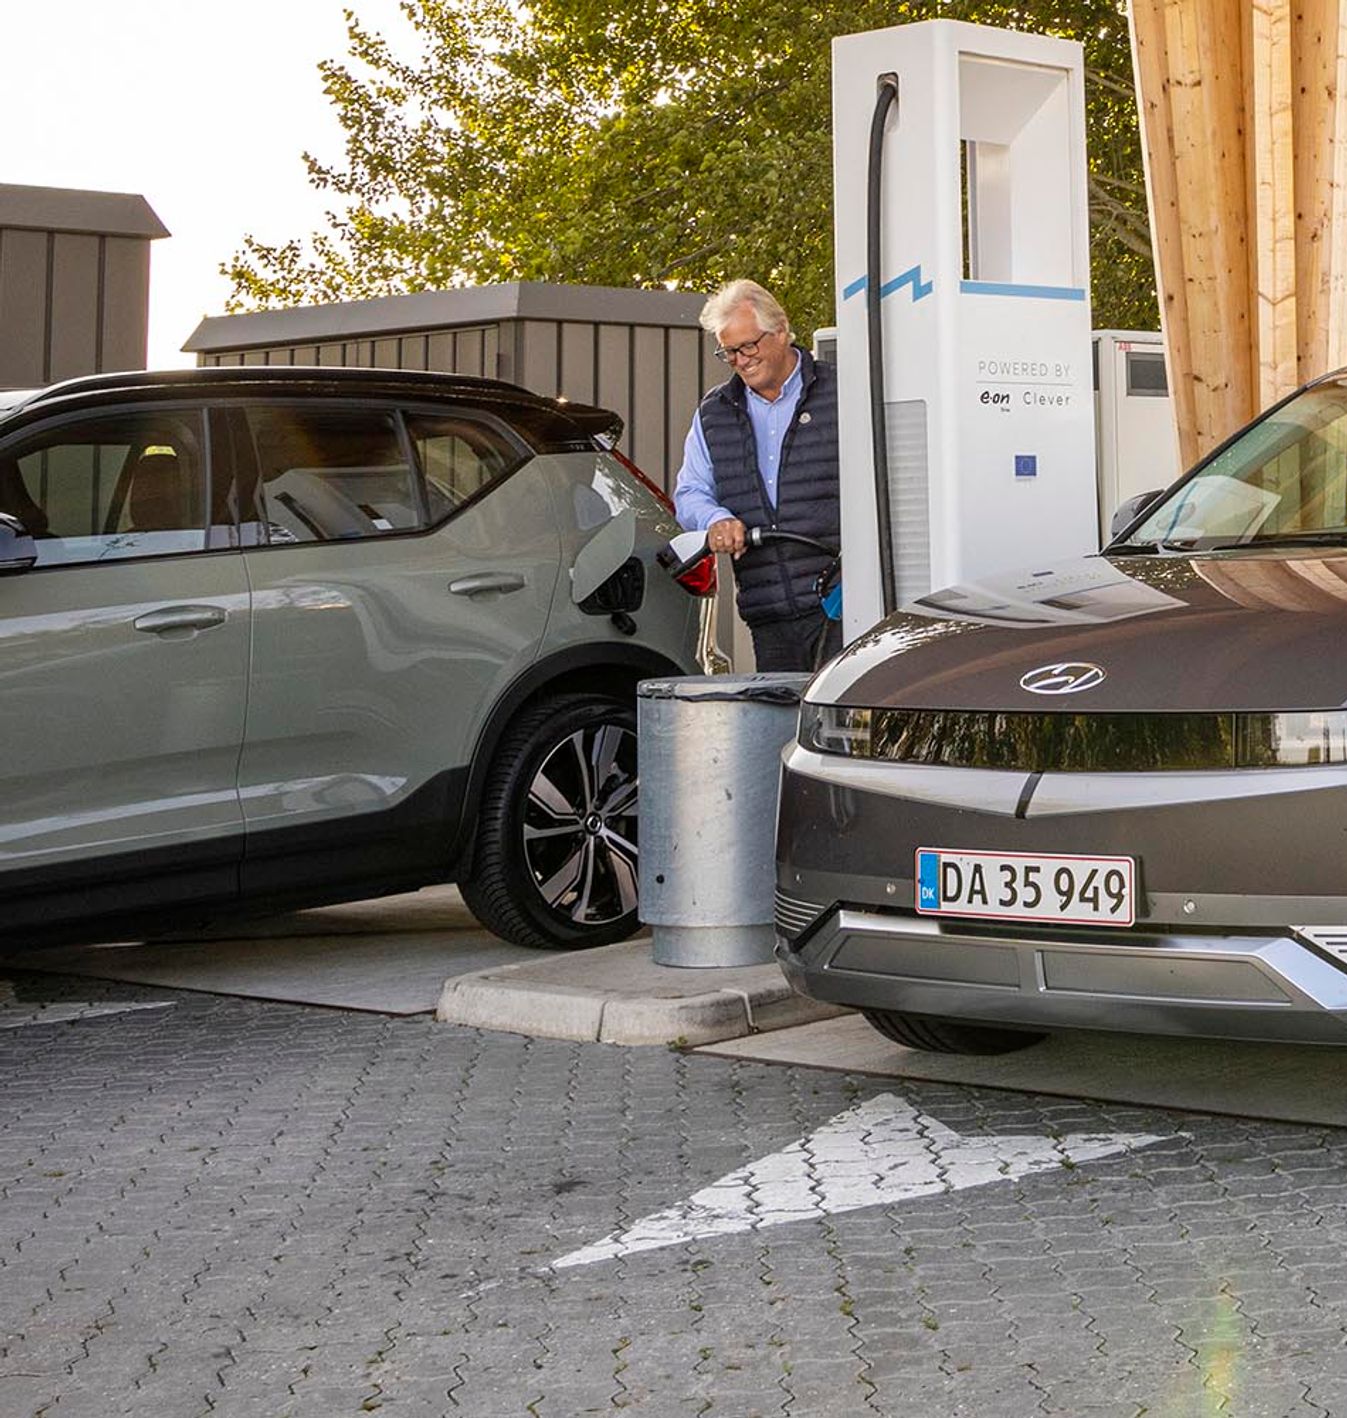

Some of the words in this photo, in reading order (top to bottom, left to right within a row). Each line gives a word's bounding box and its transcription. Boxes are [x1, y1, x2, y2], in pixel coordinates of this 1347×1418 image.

[978, 360, 1048, 377] POWERED
[1055, 363, 1070, 377] BY
[1023, 391, 1070, 406] Clever
[921, 886, 935, 900] DK
[941, 861, 988, 906] DA
[999, 864, 1042, 909] 35
[1053, 866, 1126, 915] 949
